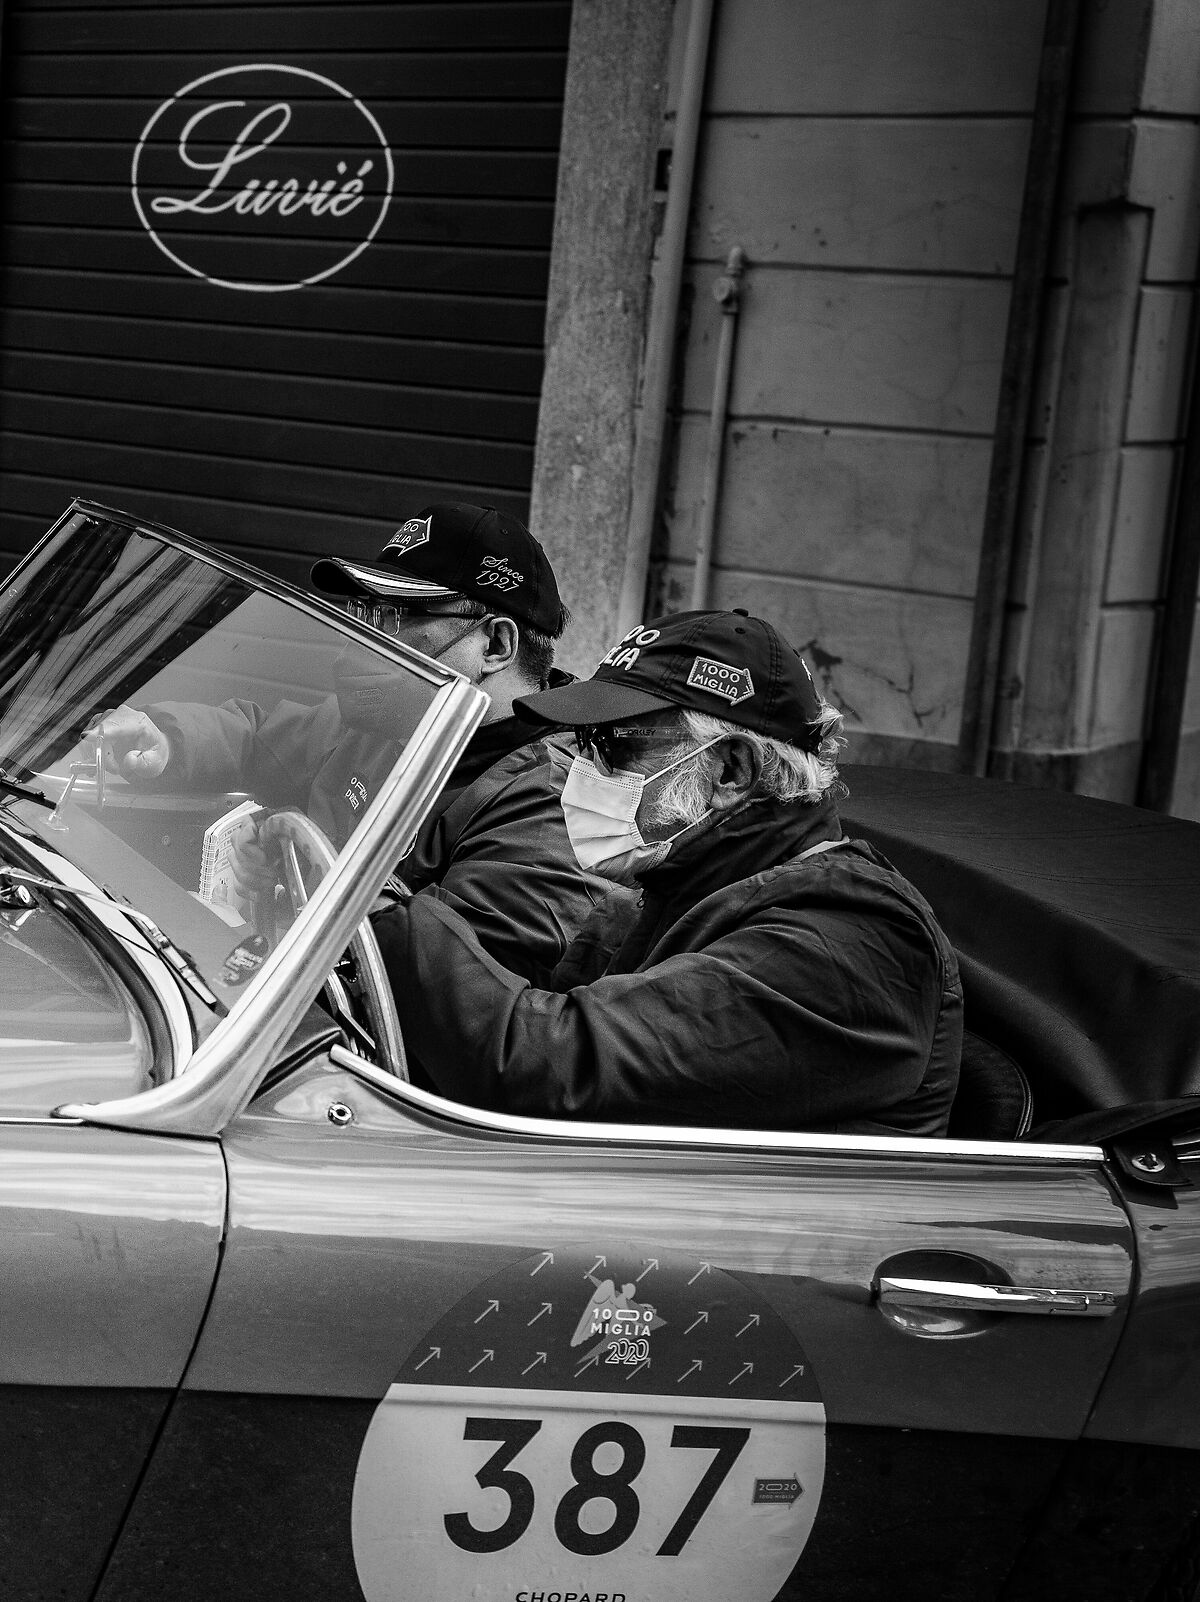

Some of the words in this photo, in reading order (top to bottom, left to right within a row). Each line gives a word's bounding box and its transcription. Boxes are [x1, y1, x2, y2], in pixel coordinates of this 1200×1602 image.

[480, 555, 524, 583] Since
[475, 570, 520, 592] 1927
[702, 662, 740, 683] 1000
[692, 673, 738, 697] MIGLIA
[590, 1322, 651, 1337] MIGLIA
[604, 1337, 650, 1365] 2020
[443, 1416, 752, 1557] 387
[515, 1591, 627, 1602] CHOPARD
